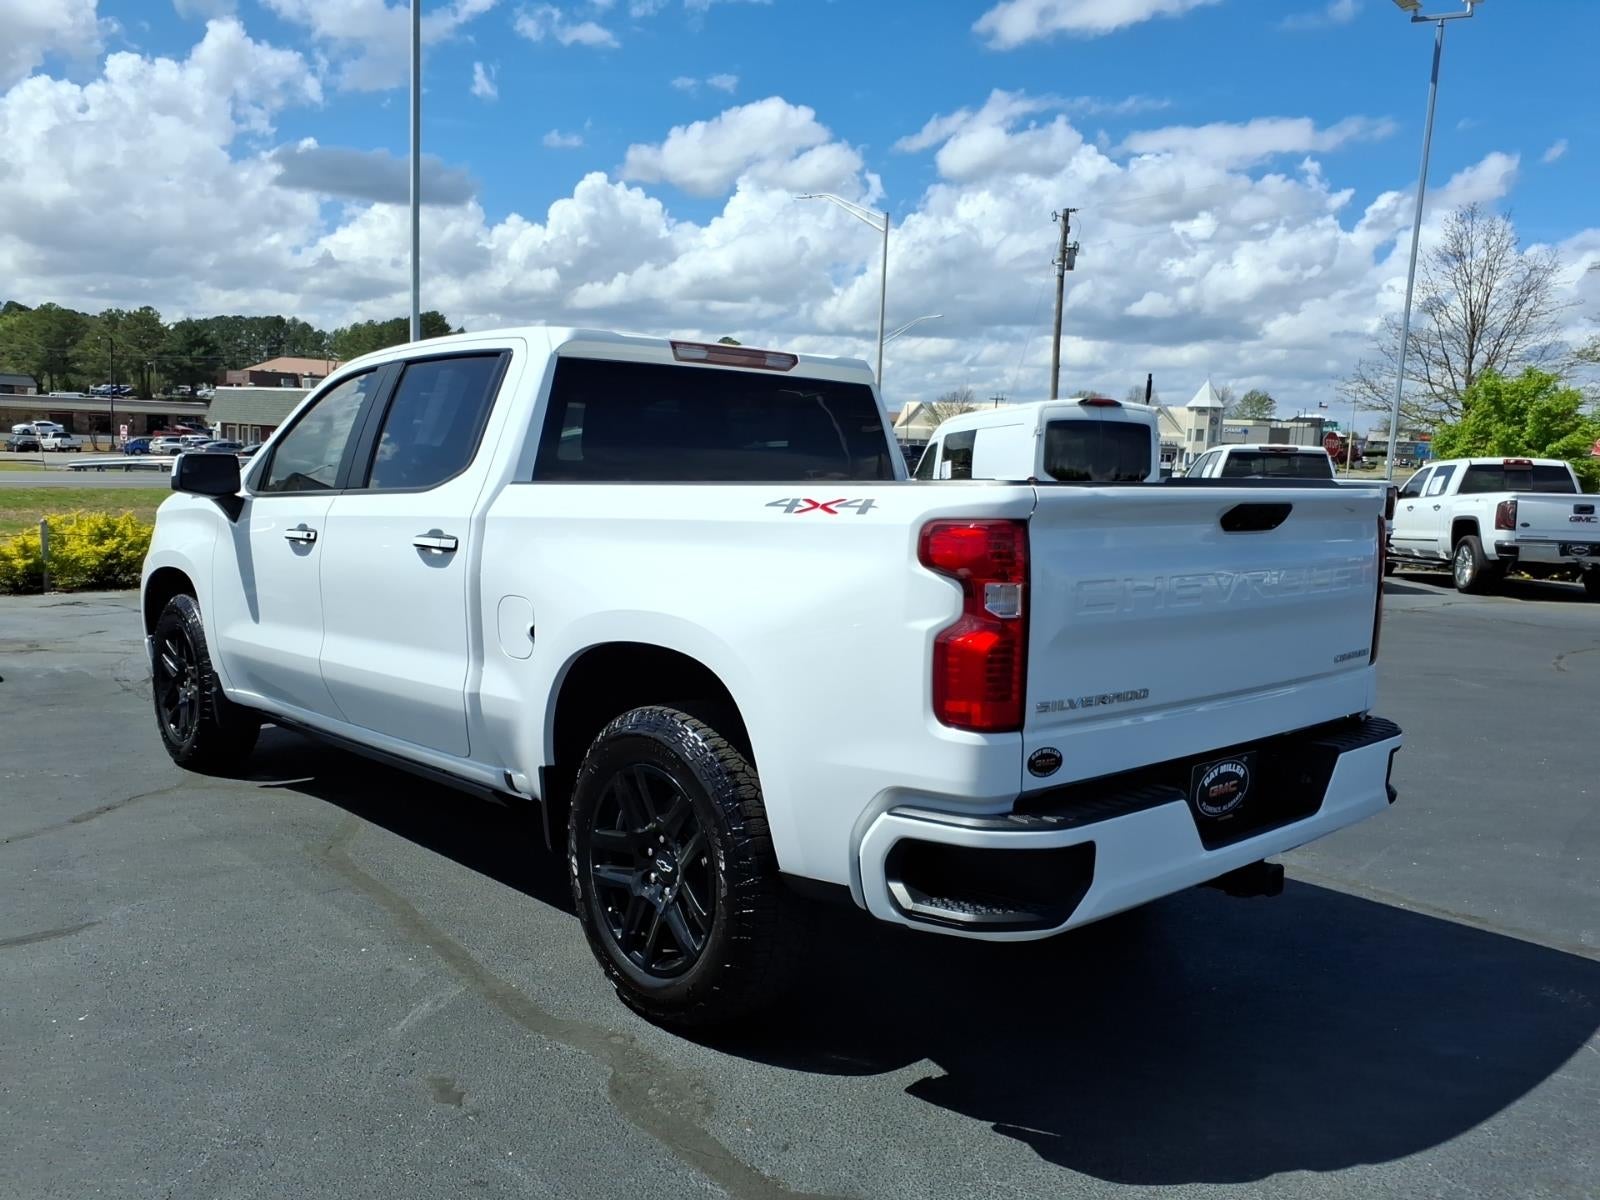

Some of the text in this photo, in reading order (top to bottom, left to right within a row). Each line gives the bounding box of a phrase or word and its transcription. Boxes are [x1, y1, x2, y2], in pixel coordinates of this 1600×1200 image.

[1325, 439, 1339, 449] STOP
[1035, 688, 1150, 713] SILVERADO
[1035, 758, 1056, 766] GMC
[1203, 763, 1245, 787] RAY MILLER
[1209, 780, 1239, 797] GMC
